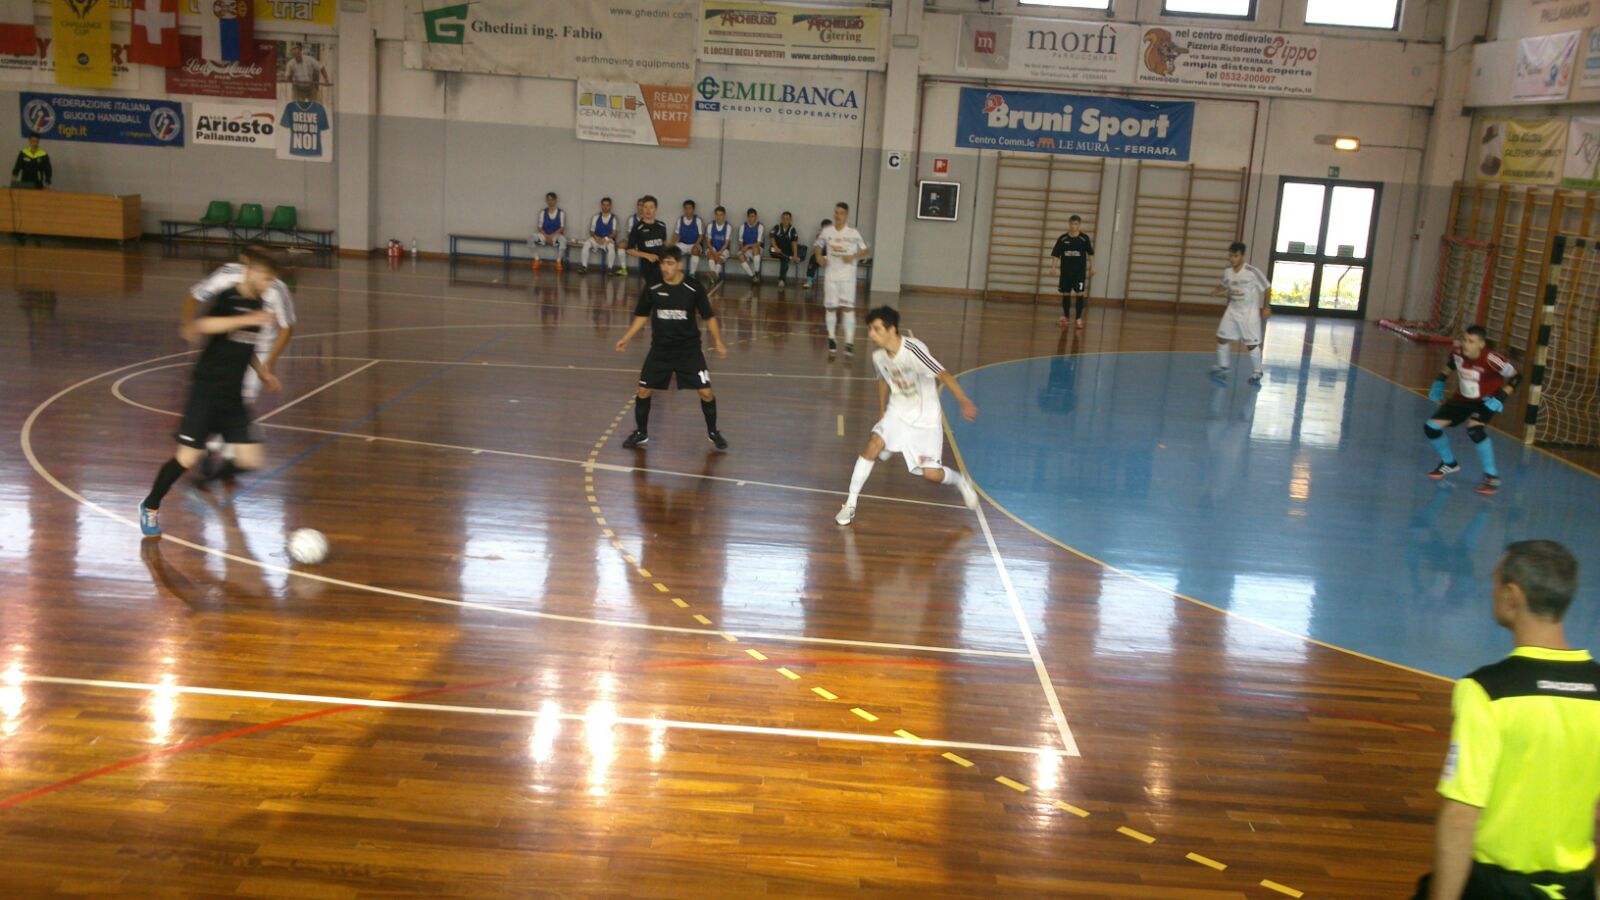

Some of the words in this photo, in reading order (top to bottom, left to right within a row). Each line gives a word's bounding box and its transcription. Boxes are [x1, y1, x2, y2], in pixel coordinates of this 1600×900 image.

[610, 7, 692, 19] www.ghedini.com
[471, 20, 528, 36] Ghedini
[532, 24, 558, 39] ing.
[563, 26, 603, 40] Fabio
[820, 29, 862, 43] Catering
[1176, 29, 1190, 39] nel
[1192, 31, 1222, 40] centro
[1225, 33, 1272, 44] medievale
[711, 47, 734, 56] LOCALE
[1187, 41, 1218, 51] Pizzeria
[1220, 44, 1262, 54] Ristorante
[1263, 36, 1317, 67] Pippo
[576, 55, 634, 68] earthmoving
[635, 59, 690, 70] equipments
[791, 53, 876, 62] www.archibugio.com
[1242, 57, 1273, 65] FERRARA
[1182, 61, 1217, 70] ampia
[1221, 62, 1263, 73] distesa
[1267, 67, 1312, 76] coperta
[1206, 71, 1218, 79] tel
[1140, 75, 1179, 83] PARCHEGGIO
[654, 92, 689, 103] READY
[52, 98, 113, 109] FEDERAZIONE
[114, 102, 152, 112] ITALIANA
[698, 102, 717, 111] BCC
[63, 111, 95, 120] GIUOCO
[97, 113, 141, 124] HANDBALL
[610, 111, 637, 119] NEXT
[653, 110, 688, 121] NEXT?
[723, 105, 772, 113] CREDITO
[778, 108, 858, 120] COOPERATIVO
[196, 115, 274, 135] Ariosto
[985, 102, 1073, 133] Bruni
[1079, 108, 1170, 142] Sport
[58, 124, 88, 137] figh.it
[196, 131, 256, 143] Pallamano
[293, 133, 318, 150] NOI
[969, 134, 996, 145] Centro
[999, 137, 1035, 147] Comm.le
[1059, 140, 1074, 149] LE
[1076, 141, 1110, 152] MURA
[1124, 145, 1177, 156] FERRARA
[889, 156, 899, 167] C
